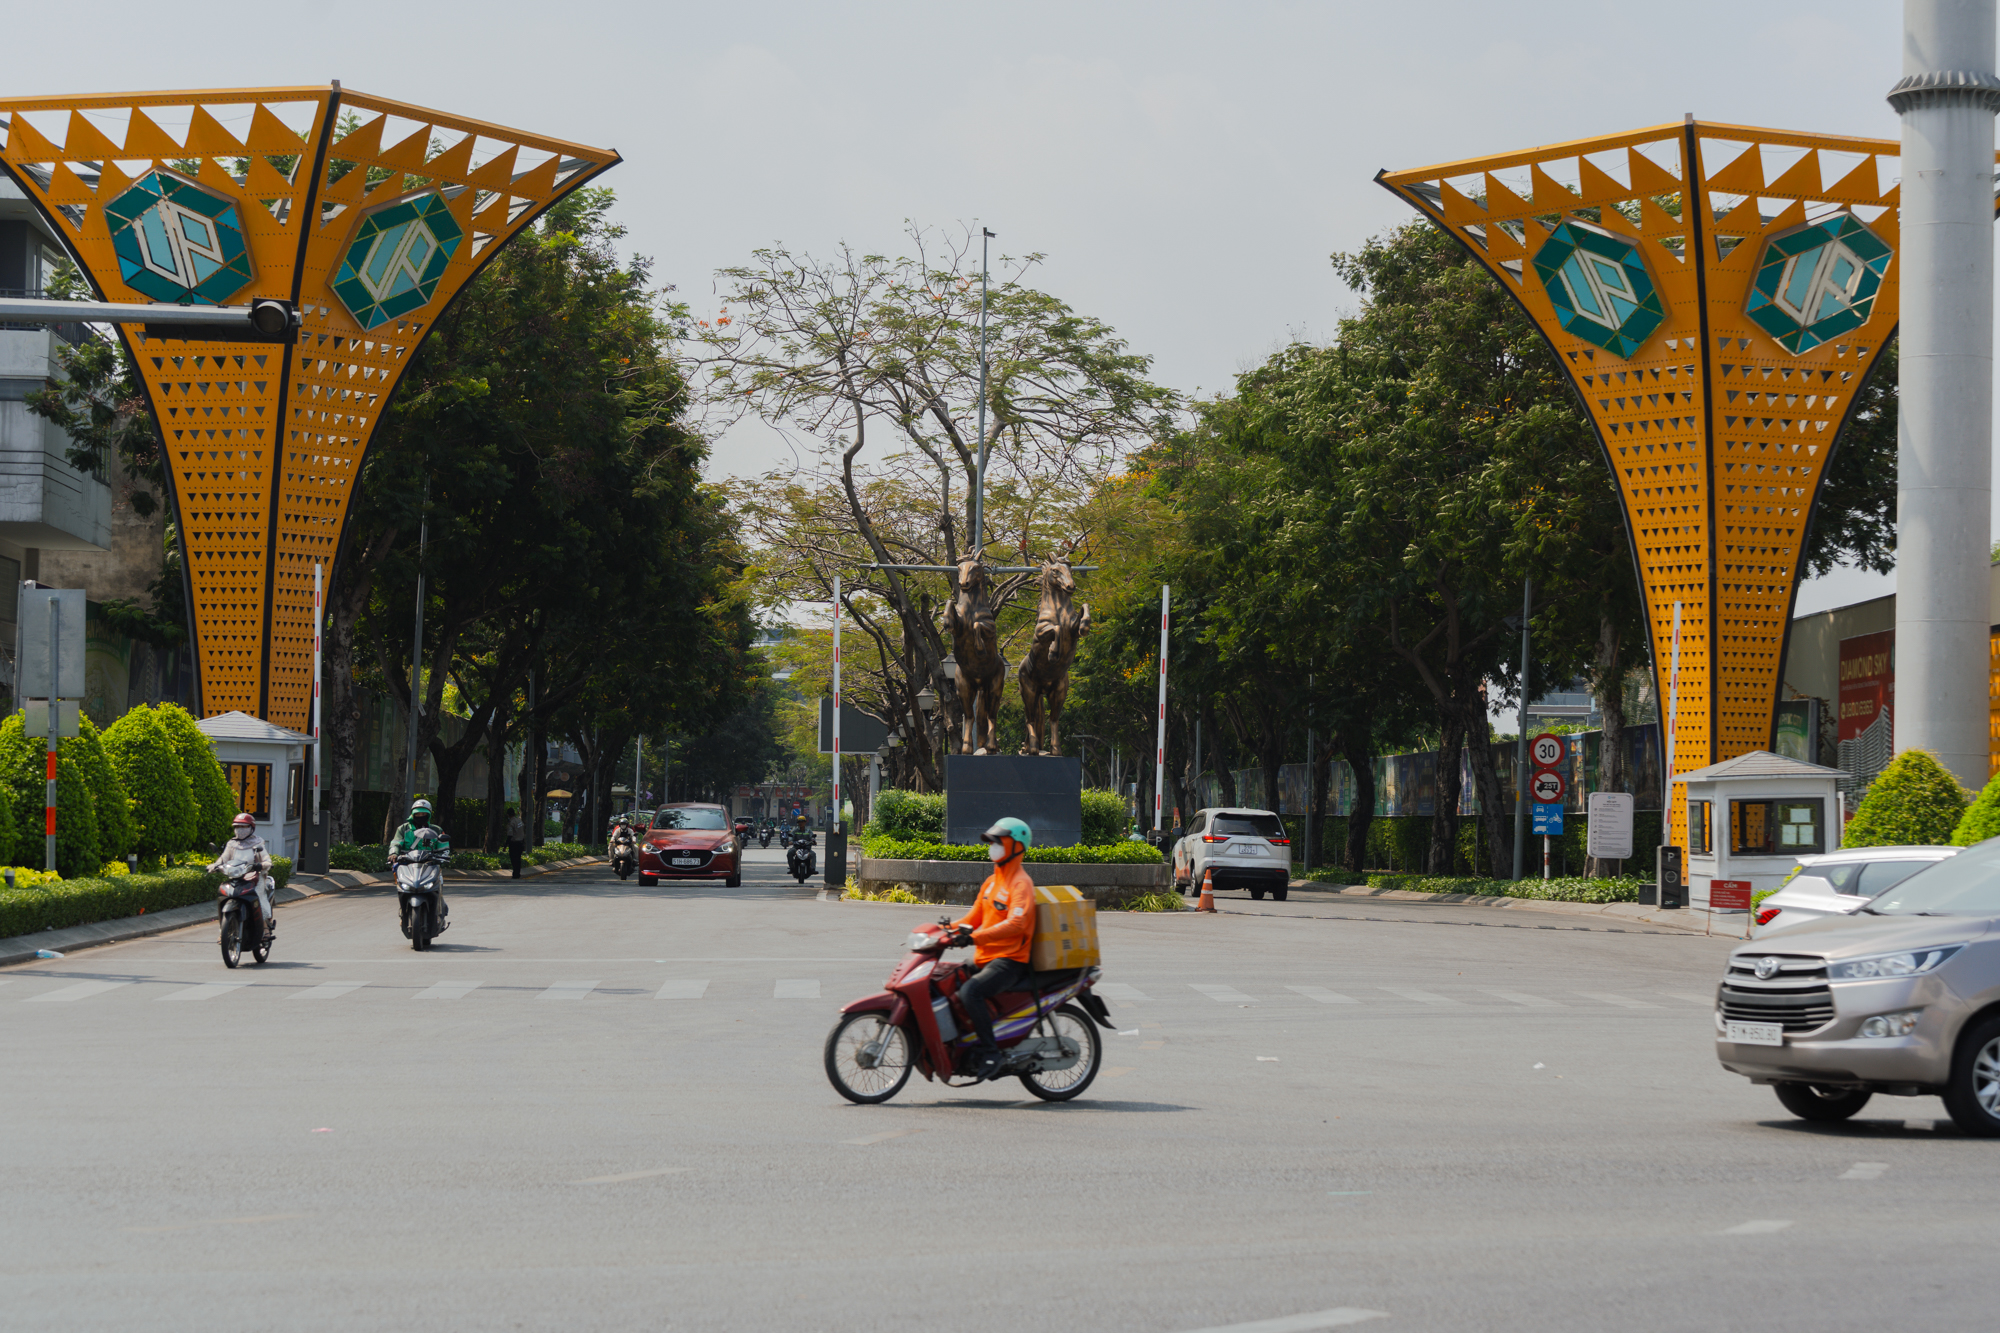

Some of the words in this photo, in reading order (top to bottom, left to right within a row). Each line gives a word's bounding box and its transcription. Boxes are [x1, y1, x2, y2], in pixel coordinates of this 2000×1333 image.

[1840, 655, 1873, 681] DIAMOND
[1874, 652, 1888, 676] SKY
[1539, 744, 1555, 759] 30
[1667, 852, 1675, 862] P
